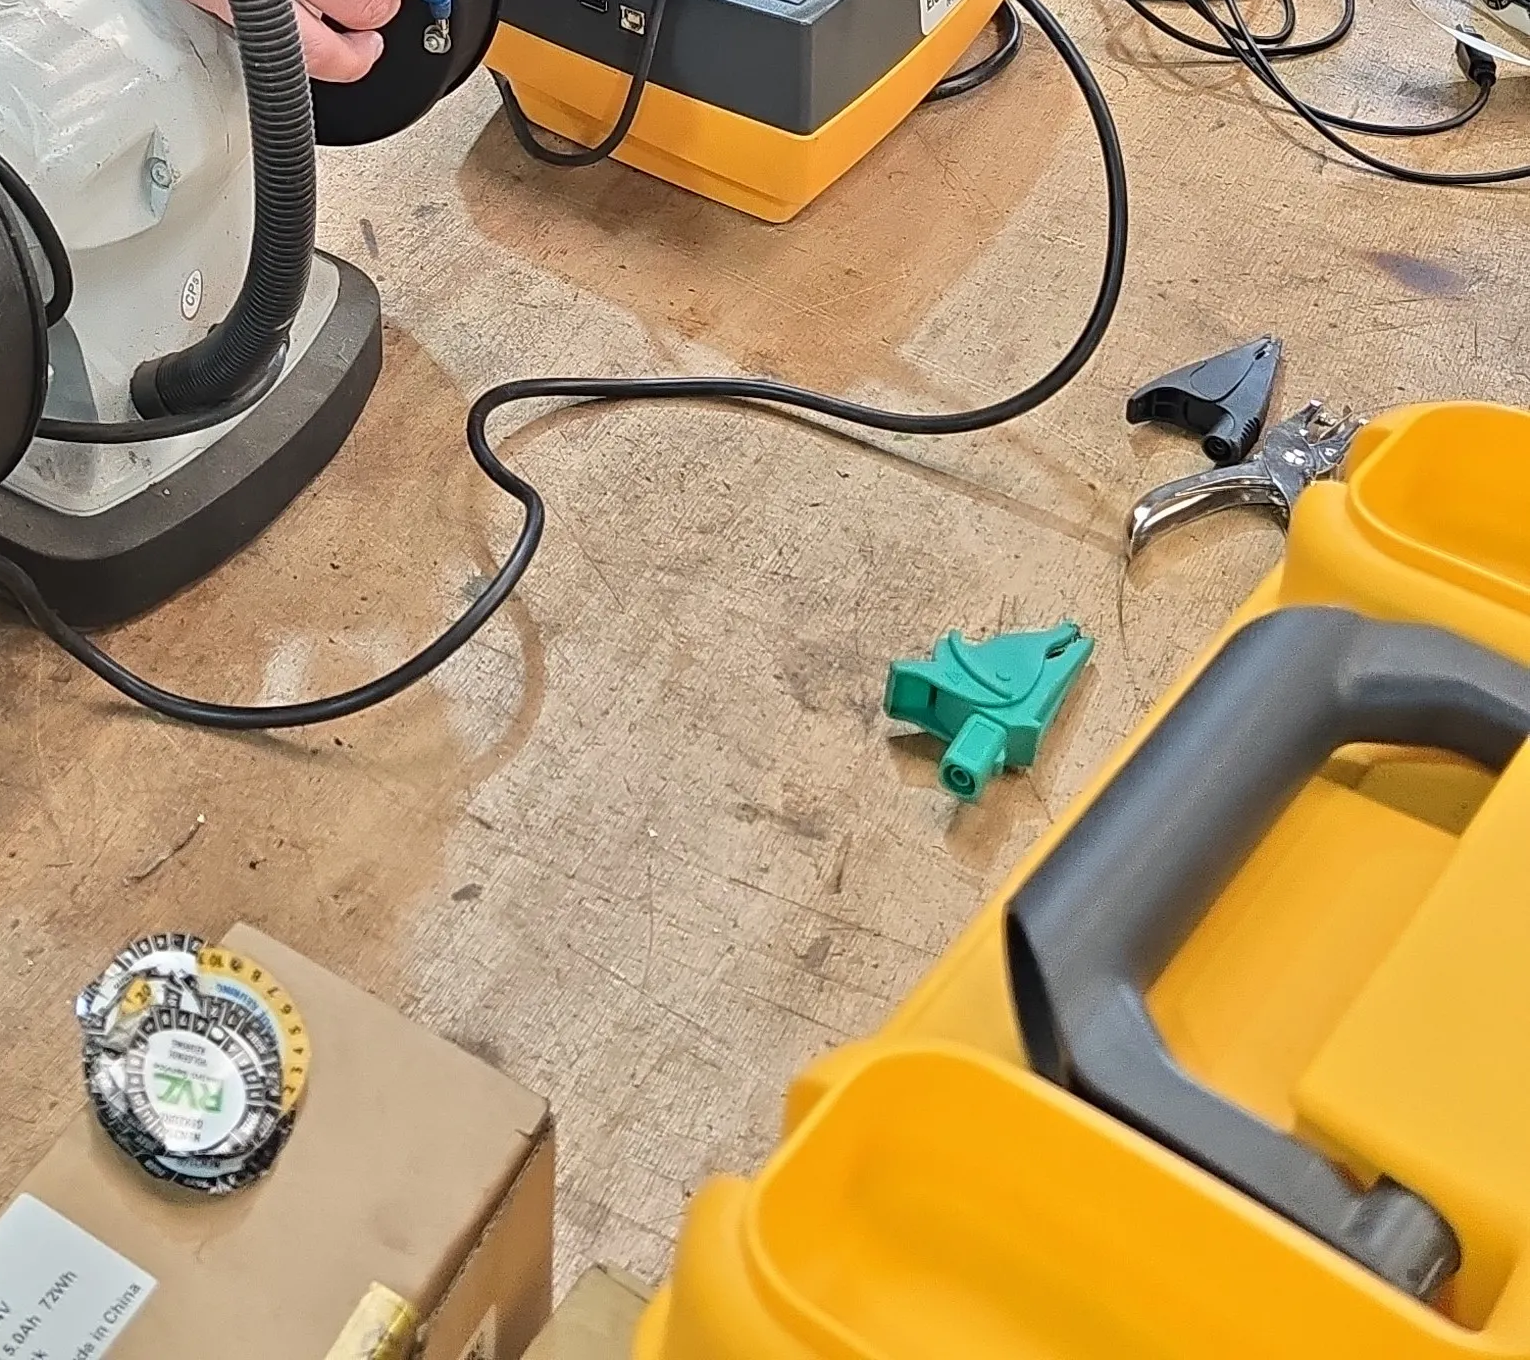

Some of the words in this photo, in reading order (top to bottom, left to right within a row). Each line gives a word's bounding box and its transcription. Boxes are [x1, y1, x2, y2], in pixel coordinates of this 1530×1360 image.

[2, 1314, 42, 1357] 5.0Ah
[37, 1270, 78, 1311] 72Wh
[90, 1324, 109, 1342] in
[102, 1283, 142, 1324] China
